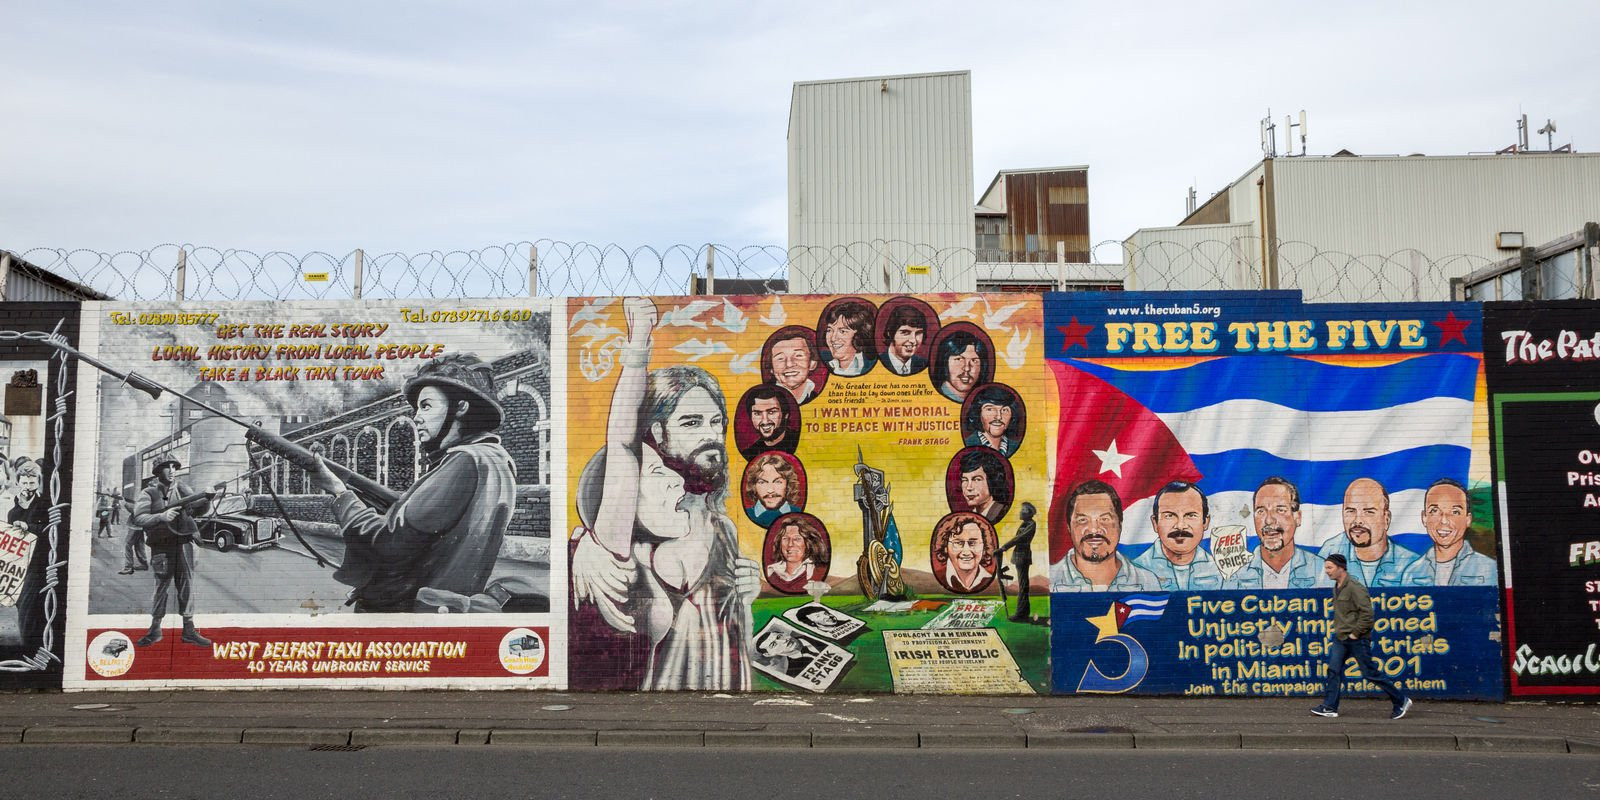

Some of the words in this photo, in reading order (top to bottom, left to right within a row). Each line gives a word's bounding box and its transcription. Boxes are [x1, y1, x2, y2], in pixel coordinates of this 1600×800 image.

[1107, 303, 1221, 318] www.thecuban5.org
[216, 324, 250, 339] GET
[253, 324, 285, 339] THE
[288, 324, 328, 339] REAL
[330, 322, 389, 339] STORY
[1104, 321, 1220, 353] FREE
[1228, 320, 1318, 352] THE
[1325, 319, 1427, 351] FIVE
[152, 344, 202, 361] LOCAL
[207, 344, 273, 361] HISTORY
[275, 343, 321, 360] FROM
[323, 343, 372, 360] LOCAL
[374, 343, 446, 360] PEOPLE
[1501, 330, 1555, 365] The
[199, 367, 236, 382] TAKE
[238, 367, 249, 382] A
[255, 367, 300, 382] BLACK
[305, 366, 338, 381] TAXI
[342, 366, 385, 381] TOUR
[846, 381, 872, 390] Greater
[889, 381, 900, 389] has
[924, 388, 934, 396] for
[814, 408, 818, 418] I
[821, 407, 859, 418] WANT
[862, 407, 881, 418] MY
[884, 406, 951, 417] MEMORIAL
[805, 422, 820, 433] TO
[824, 422, 837, 433] BE
[841, 422, 879, 433] PEACE
[882, 421, 913, 432] WITH
[916, 420, 960, 432] JUSTICE
[924, 437, 950, 446] STAGG
[1583, 493, 1600, 507] A
[1217, 533, 1242, 548] FREE
[1218, 554, 1249, 570] PRICE
[956, 604, 987, 612] FREE
[1186, 595, 1236, 616] Five
[1240, 594, 1318, 614] Cuban
[1323, 592, 1434, 619] priots
[1297, 611, 1438, 640] imponed
[212, 641, 261, 661] WEST
[262, 641, 326, 660] BELFAST
[327, 641, 364, 660] TAXI
[365, 641, 468, 660] ASSOCIATION
[894, 650, 932, 660] IRISH
[937, 649, 1000, 659] REPUBLIC
[1178, 640, 1200, 660] In
[1204, 637, 1302, 665] political
[1378, 633, 1450, 655] trials
[246, 660, 266, 673] 40
[268, 660, 309, 673] YEARS
[311, 660, 382, 673] UNBROKEN
[384, 660, 431, 673] SERVICE
[801, 650, 836, 680] FRANK
[811, 655, 843, 686] STAGG
[1211, 662, 1232, 681] in
[1237, 660, 1310, 681] Miami
[1184, 683, 1215, 695] Join
[1222, 680, 1248, 694] the
[1347, 679, 1402, 692] relee
[1405, 678, 1448, 691] them
